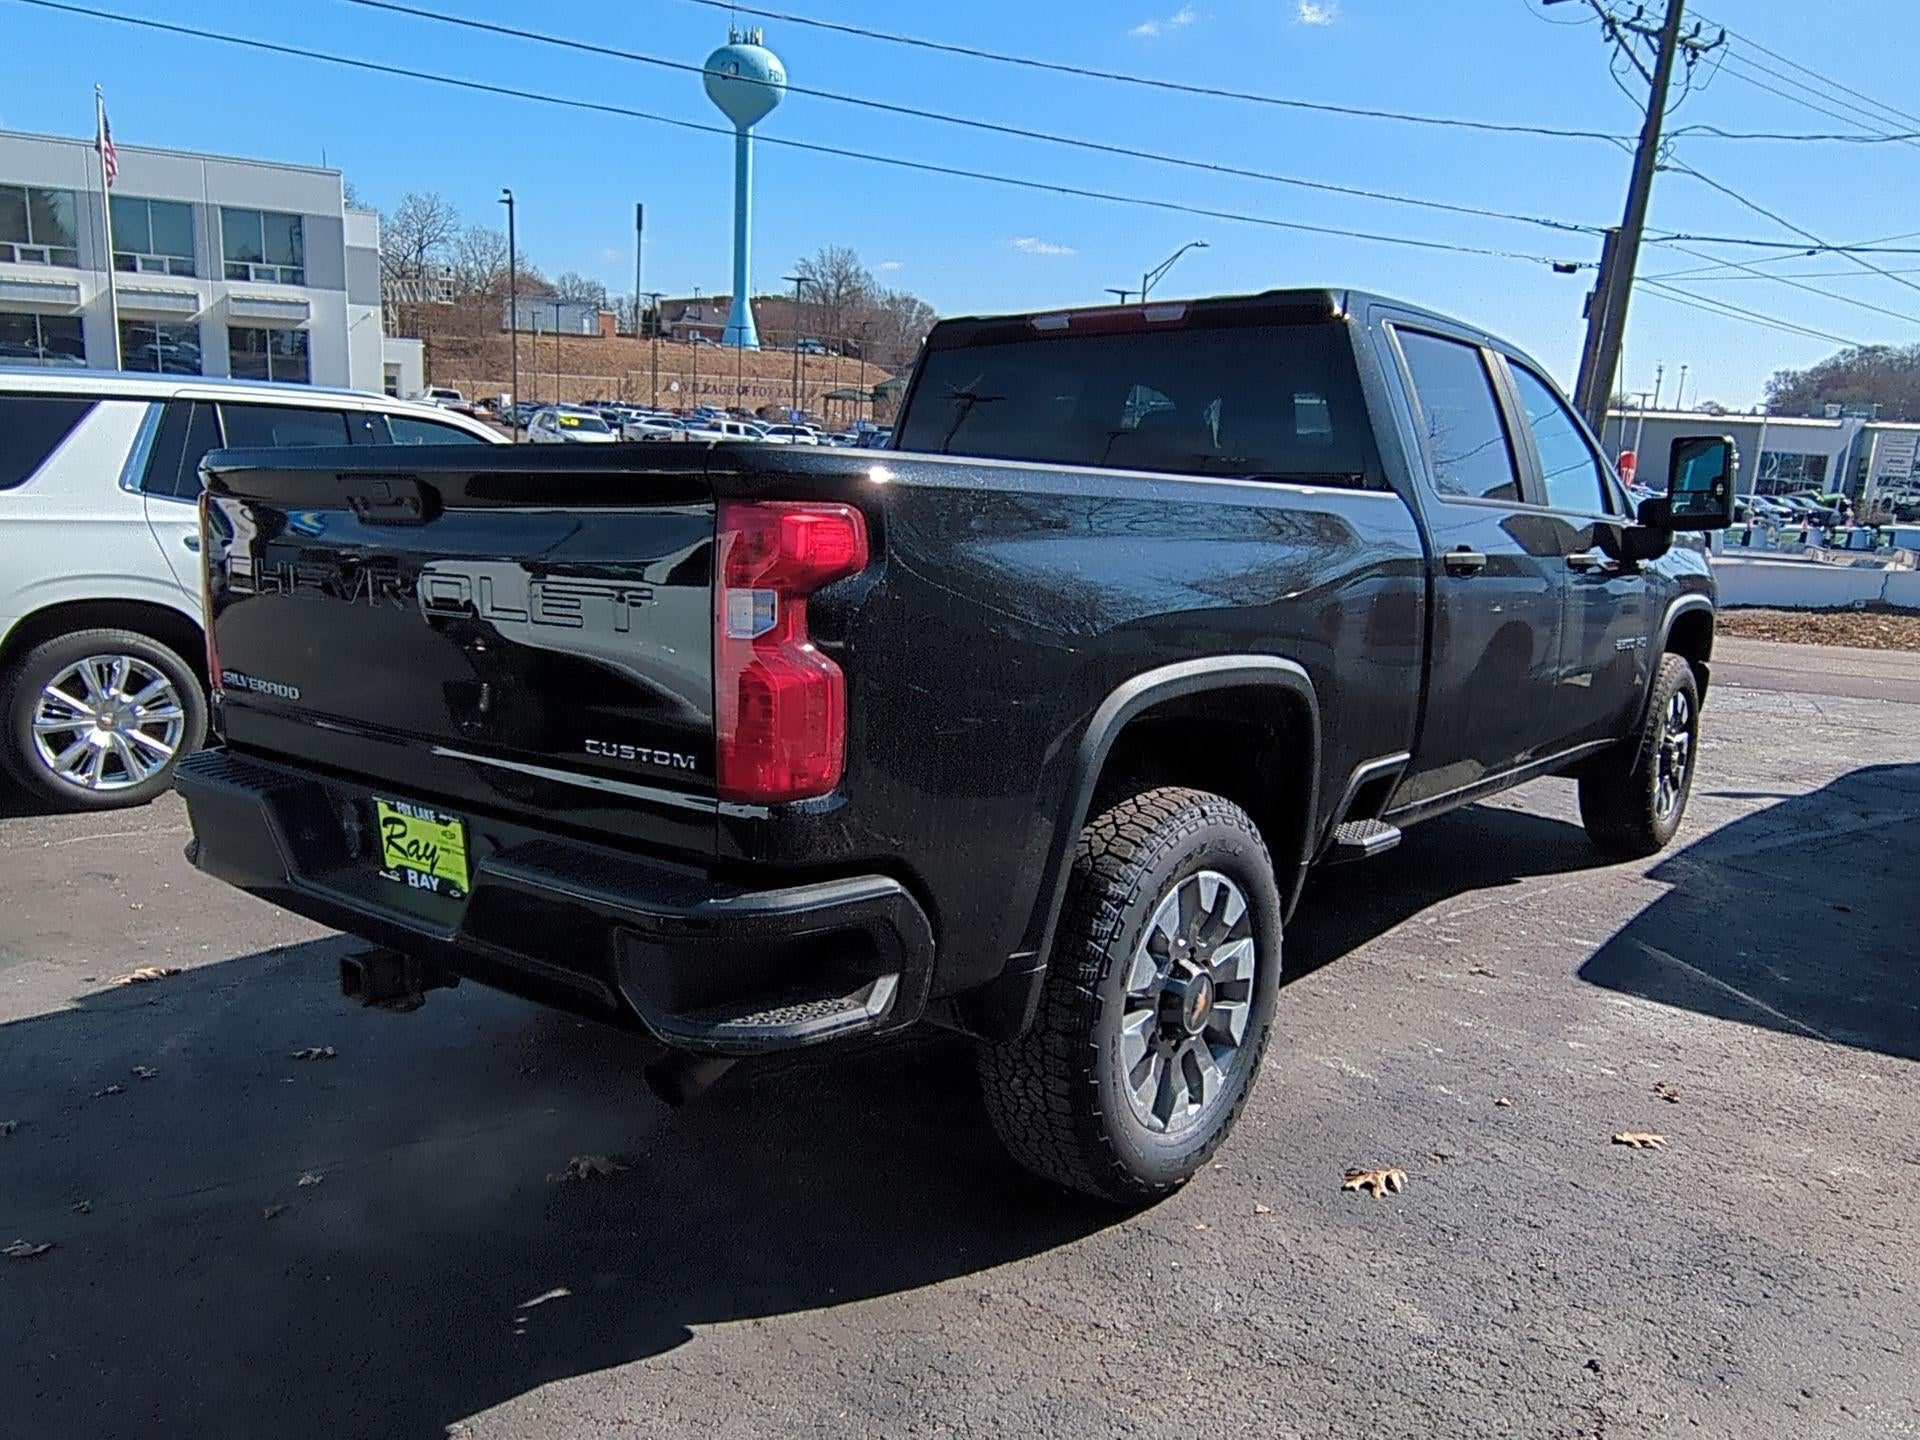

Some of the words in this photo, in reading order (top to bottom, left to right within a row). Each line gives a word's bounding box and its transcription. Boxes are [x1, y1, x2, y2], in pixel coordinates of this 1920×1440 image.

[227, 554, 654, 634] CHEVROLET
[222, 671, 300, 700] SILVERADO
[585, 739, 695, 770] CUSTOM
[382, 816, 440, 875] Ray
[406, 869, 439, 892] BAY
